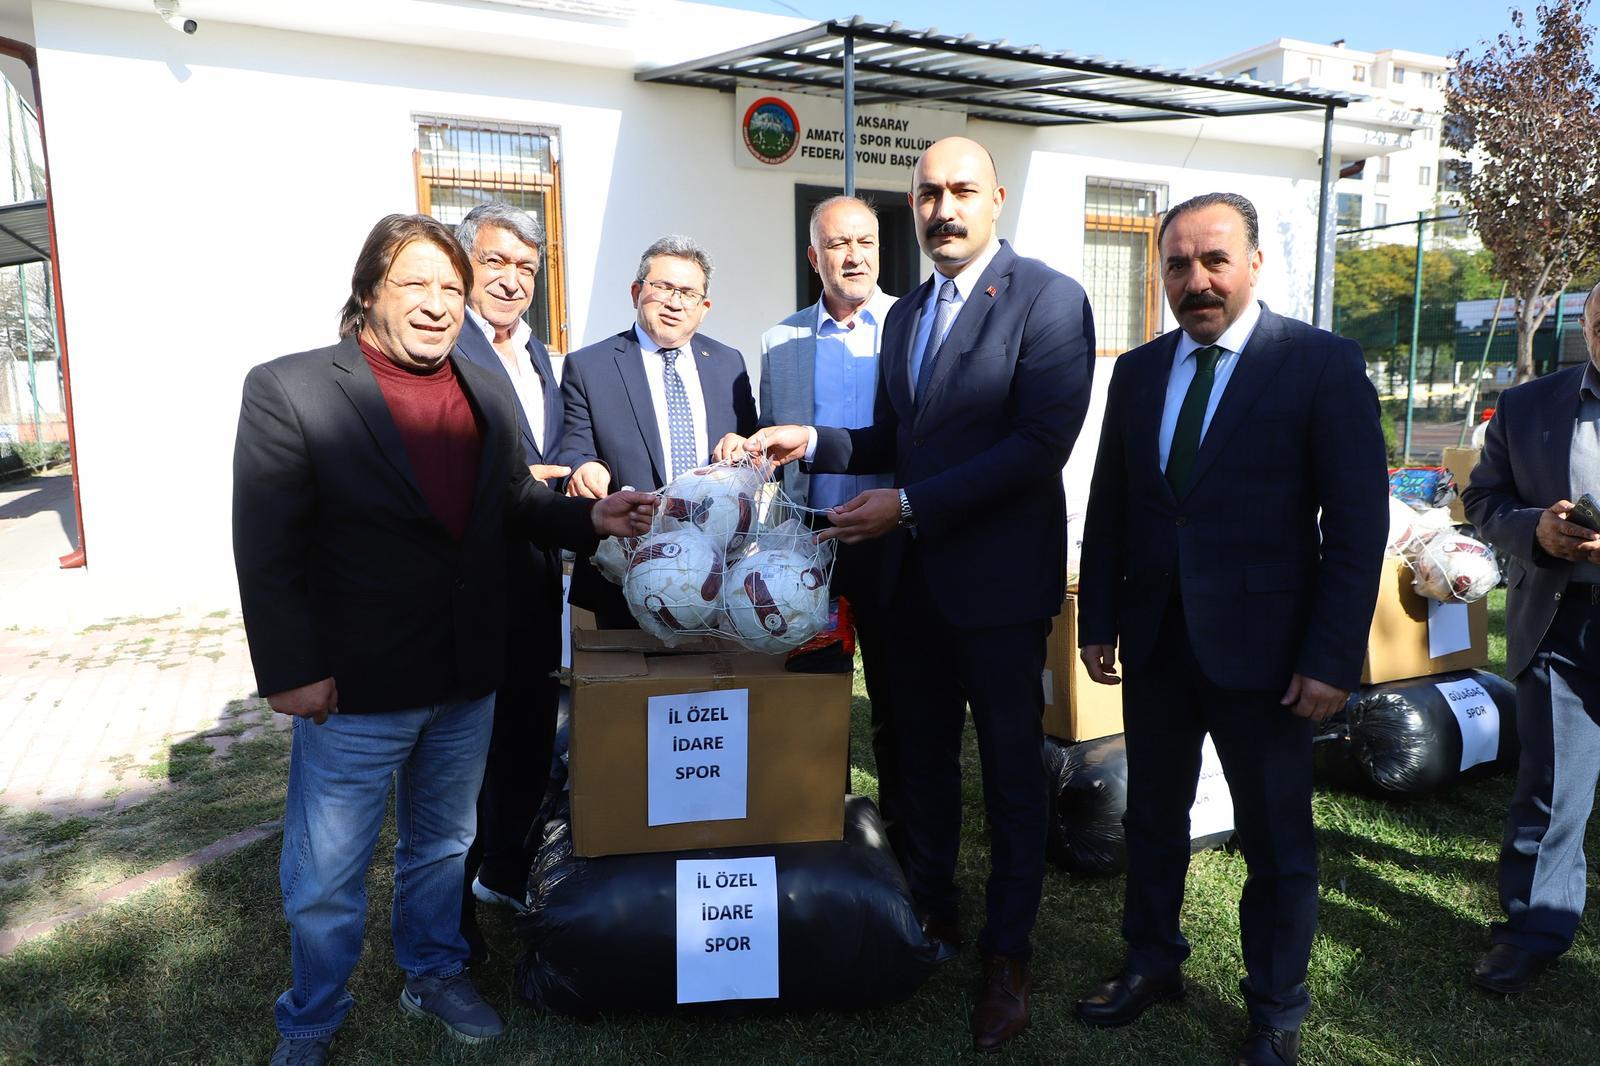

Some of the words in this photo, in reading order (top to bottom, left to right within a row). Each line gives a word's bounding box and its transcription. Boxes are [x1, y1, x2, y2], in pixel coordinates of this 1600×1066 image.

[856, 114, 909, 132] AKSARAY
[806, 128, 856, 145] AMAT
[860, 133, 892, 148] SPOR
[895, 137, 937, 151] KULÜP
[801, 145, 887, 165] FEDERYONU
[890, 154, 921, 170] BAŞK
[1448, 686, 1485, 702] GÜLAĞAÇ
[669, 708, 683, 725] İL
[687, 706, 729, 723] ÖZEL
[1466, 705, 1487, 719] SPOR
[673, 736, 724, 752] İDARE
[675, 764, 721, 780] SPOR
[697, 872, 711, 889] İL
[715, 871, 758, 888] ÖZEL
[702, 902, 753, 921] İDARE
[705, 936, 751, 953] SPOR
